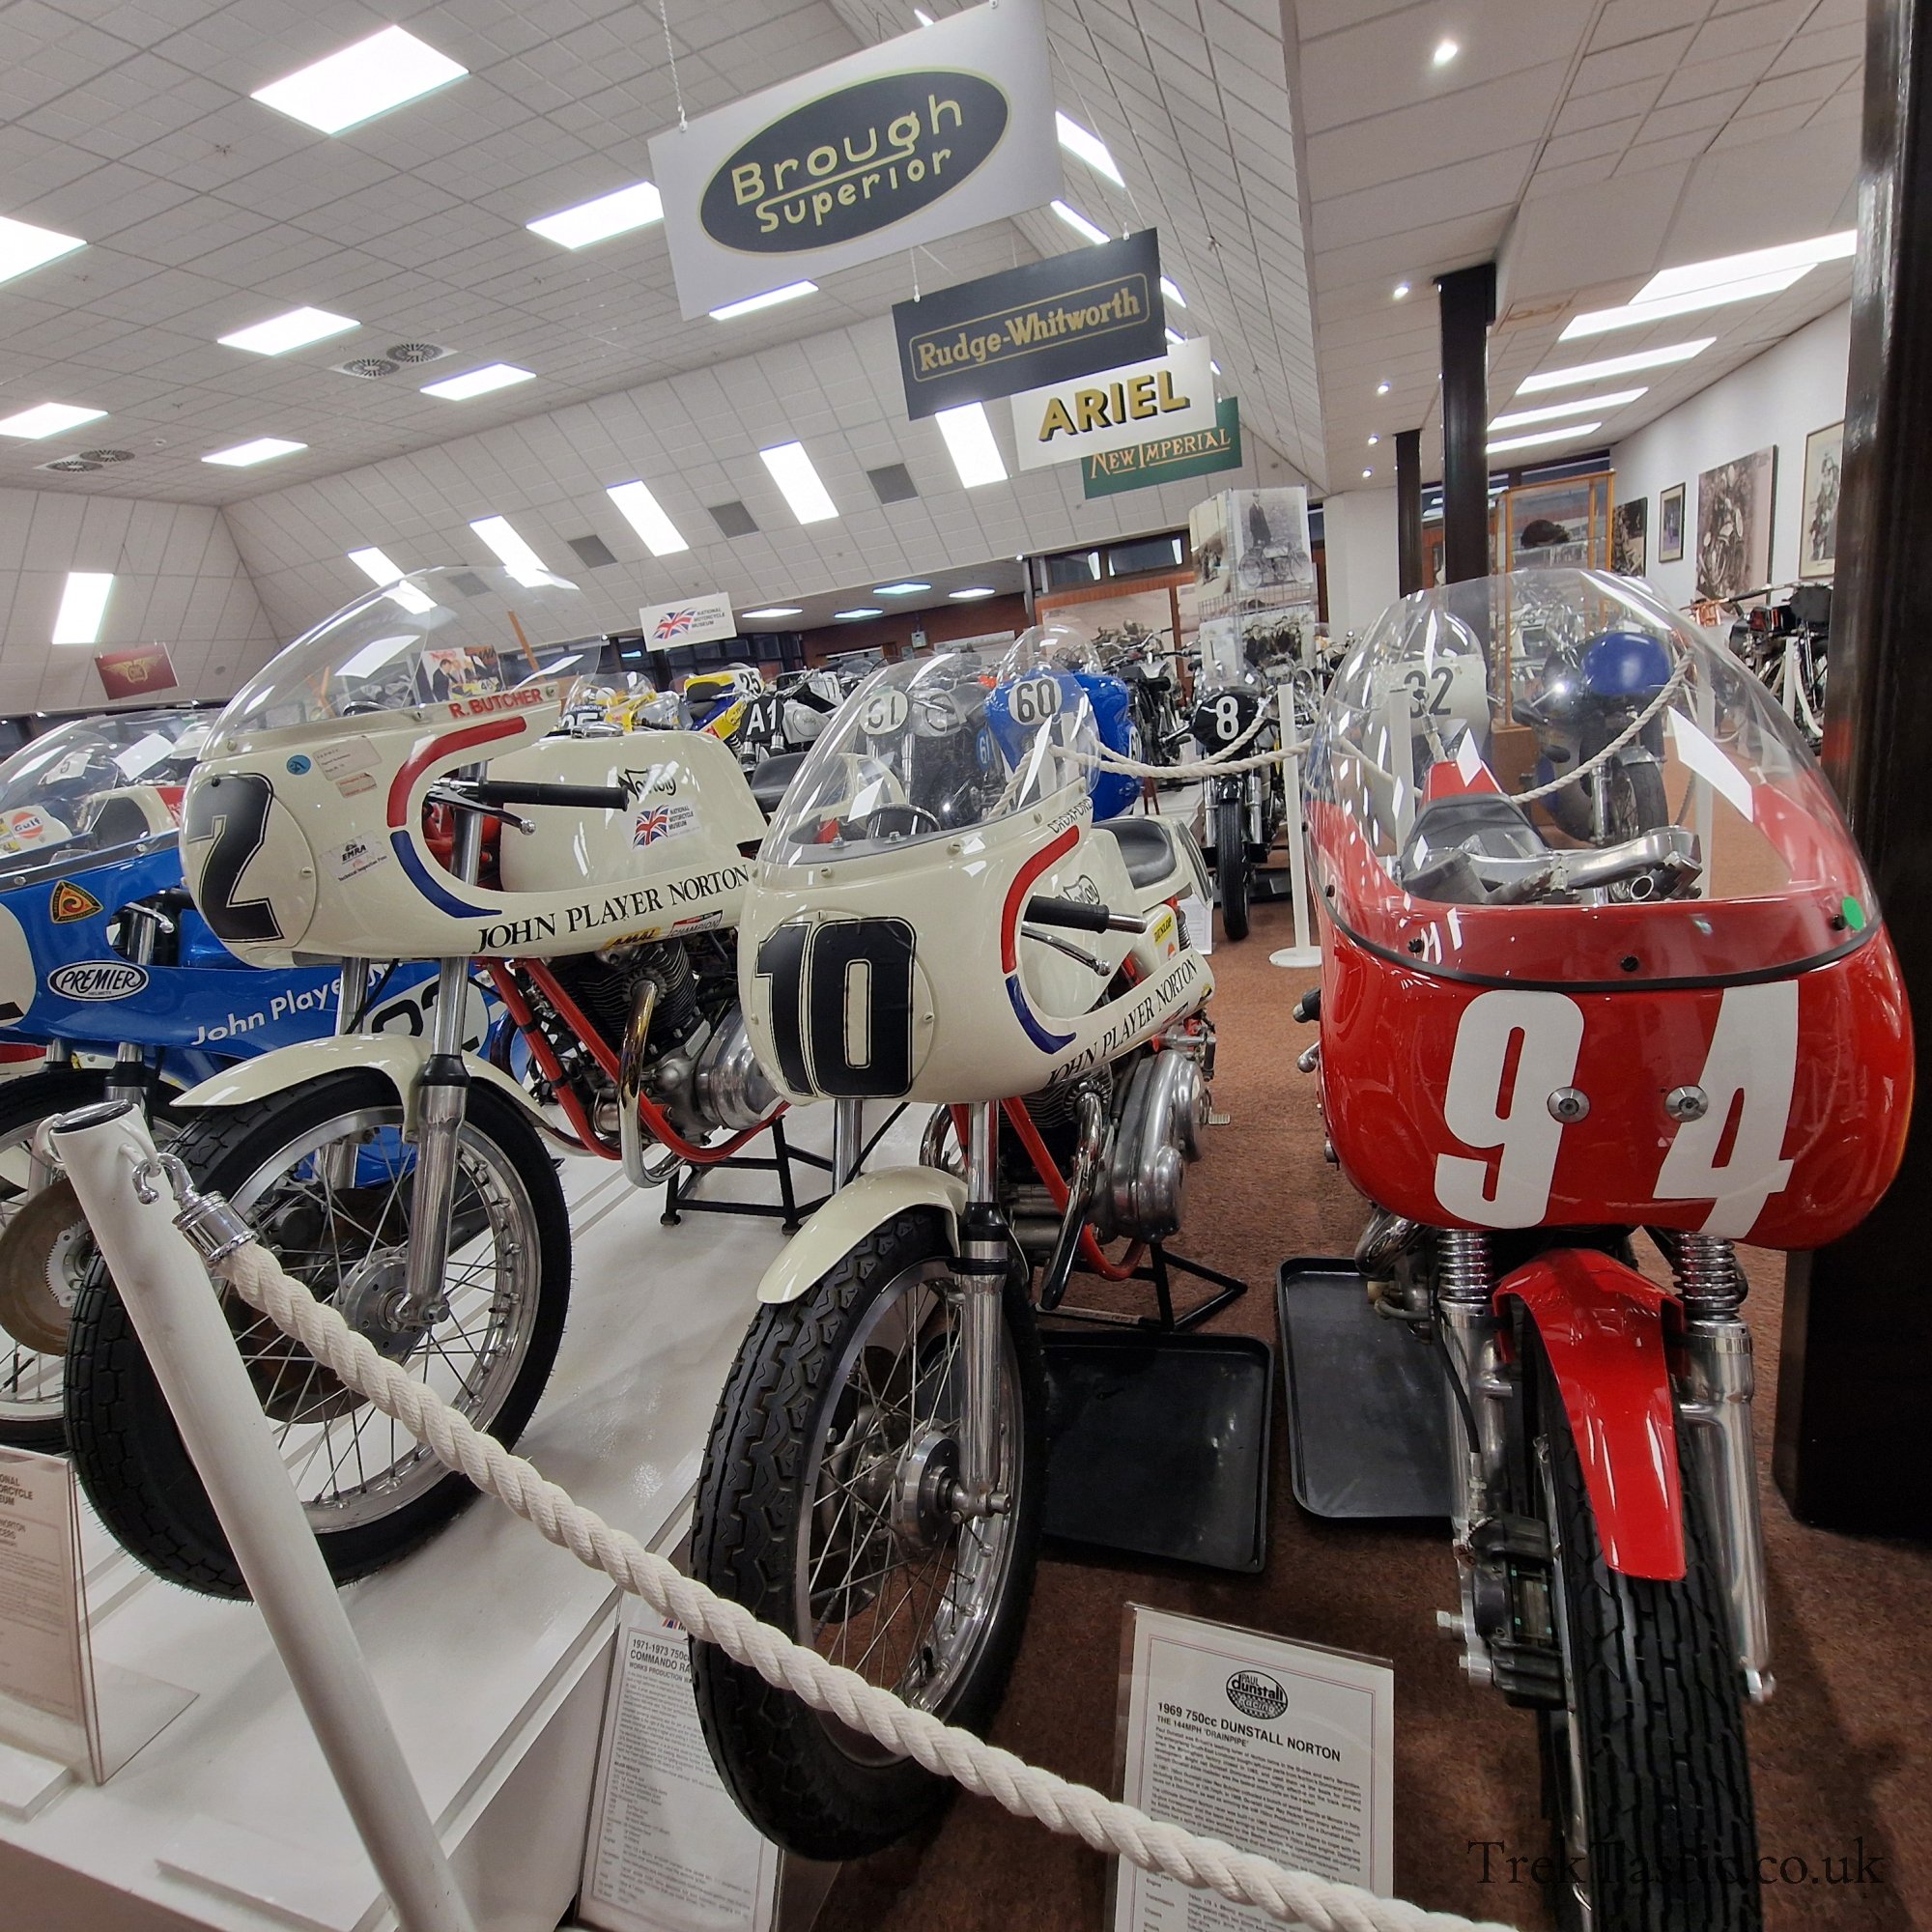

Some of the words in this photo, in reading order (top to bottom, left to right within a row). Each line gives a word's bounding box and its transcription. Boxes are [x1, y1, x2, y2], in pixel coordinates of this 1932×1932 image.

[731, 95, 963, 206] Brough
[754, 146, 952, 233] Superior
[918, 288, 1141, 372] Rudge-Whitworth
[1038, 370, 1191, 442] ARIEL
[694, 612, 725, 621] MOTORCYCLE
[738, 672, 761, 696] 25
[448, 703, 470, 719] R.
[469, 688, 543, 714] BUTCHER
[1016, 678, 1057, 723] 60
[747, 699, 777, 735] A1
[1215, 696, 1239, 740] 8
[14, 817, 41, 832] Gulf
[668, 811, 695, 822] MOTORCYCLE
[669, 806, 690, 814] NATIONAL
[668, 820, 687, 830] MUSEUM
[187, 772, 285, 943] 2
[342, 844, 366, 861] EMRA
[472, 913, 556, 954] JOHN
[566, 889, 664, 933] PLAYER
[668, 865, 750, 906] NORTON
[60, 969, 136, 993] PREMIER
[191, 1012, 266, 1045] John
[270, 976, 341, 1021] Playe
[754, 916, 917, 1099] 10
[1046, 1042, 1097, 1086] JOHN
[1101, 996, 1154, 1058] PLAYER
[1155, 954, 1200, 1012] NORTON
[1435, 980, 1800, 1239] 94
[631, 1650, 677, 1670] COMMANDO
[633, 1639, 668, 1656] 1971-1973
[629, 1662, 647, 1672] WORKS
[649, 1666, 683, 1681] PRODUCTION
[1241, 1673, 1259, 1687] PAUL
[1232, 1674, 1283, 1701] dunstall
[1239, 1694, 1275, 1716] Racing
[1157, 1715, 1172, 1725] THE
[1174, 1719, 1202, 1734] 144MPH
[1158, 1702, 1182, 1718] 1969
[1185, 1709, 1218, 1727] 750cc
[1221, 1719, 1284, 1747] DUNSTALL
[1287, 1737, 1341, 1762] NORTON
